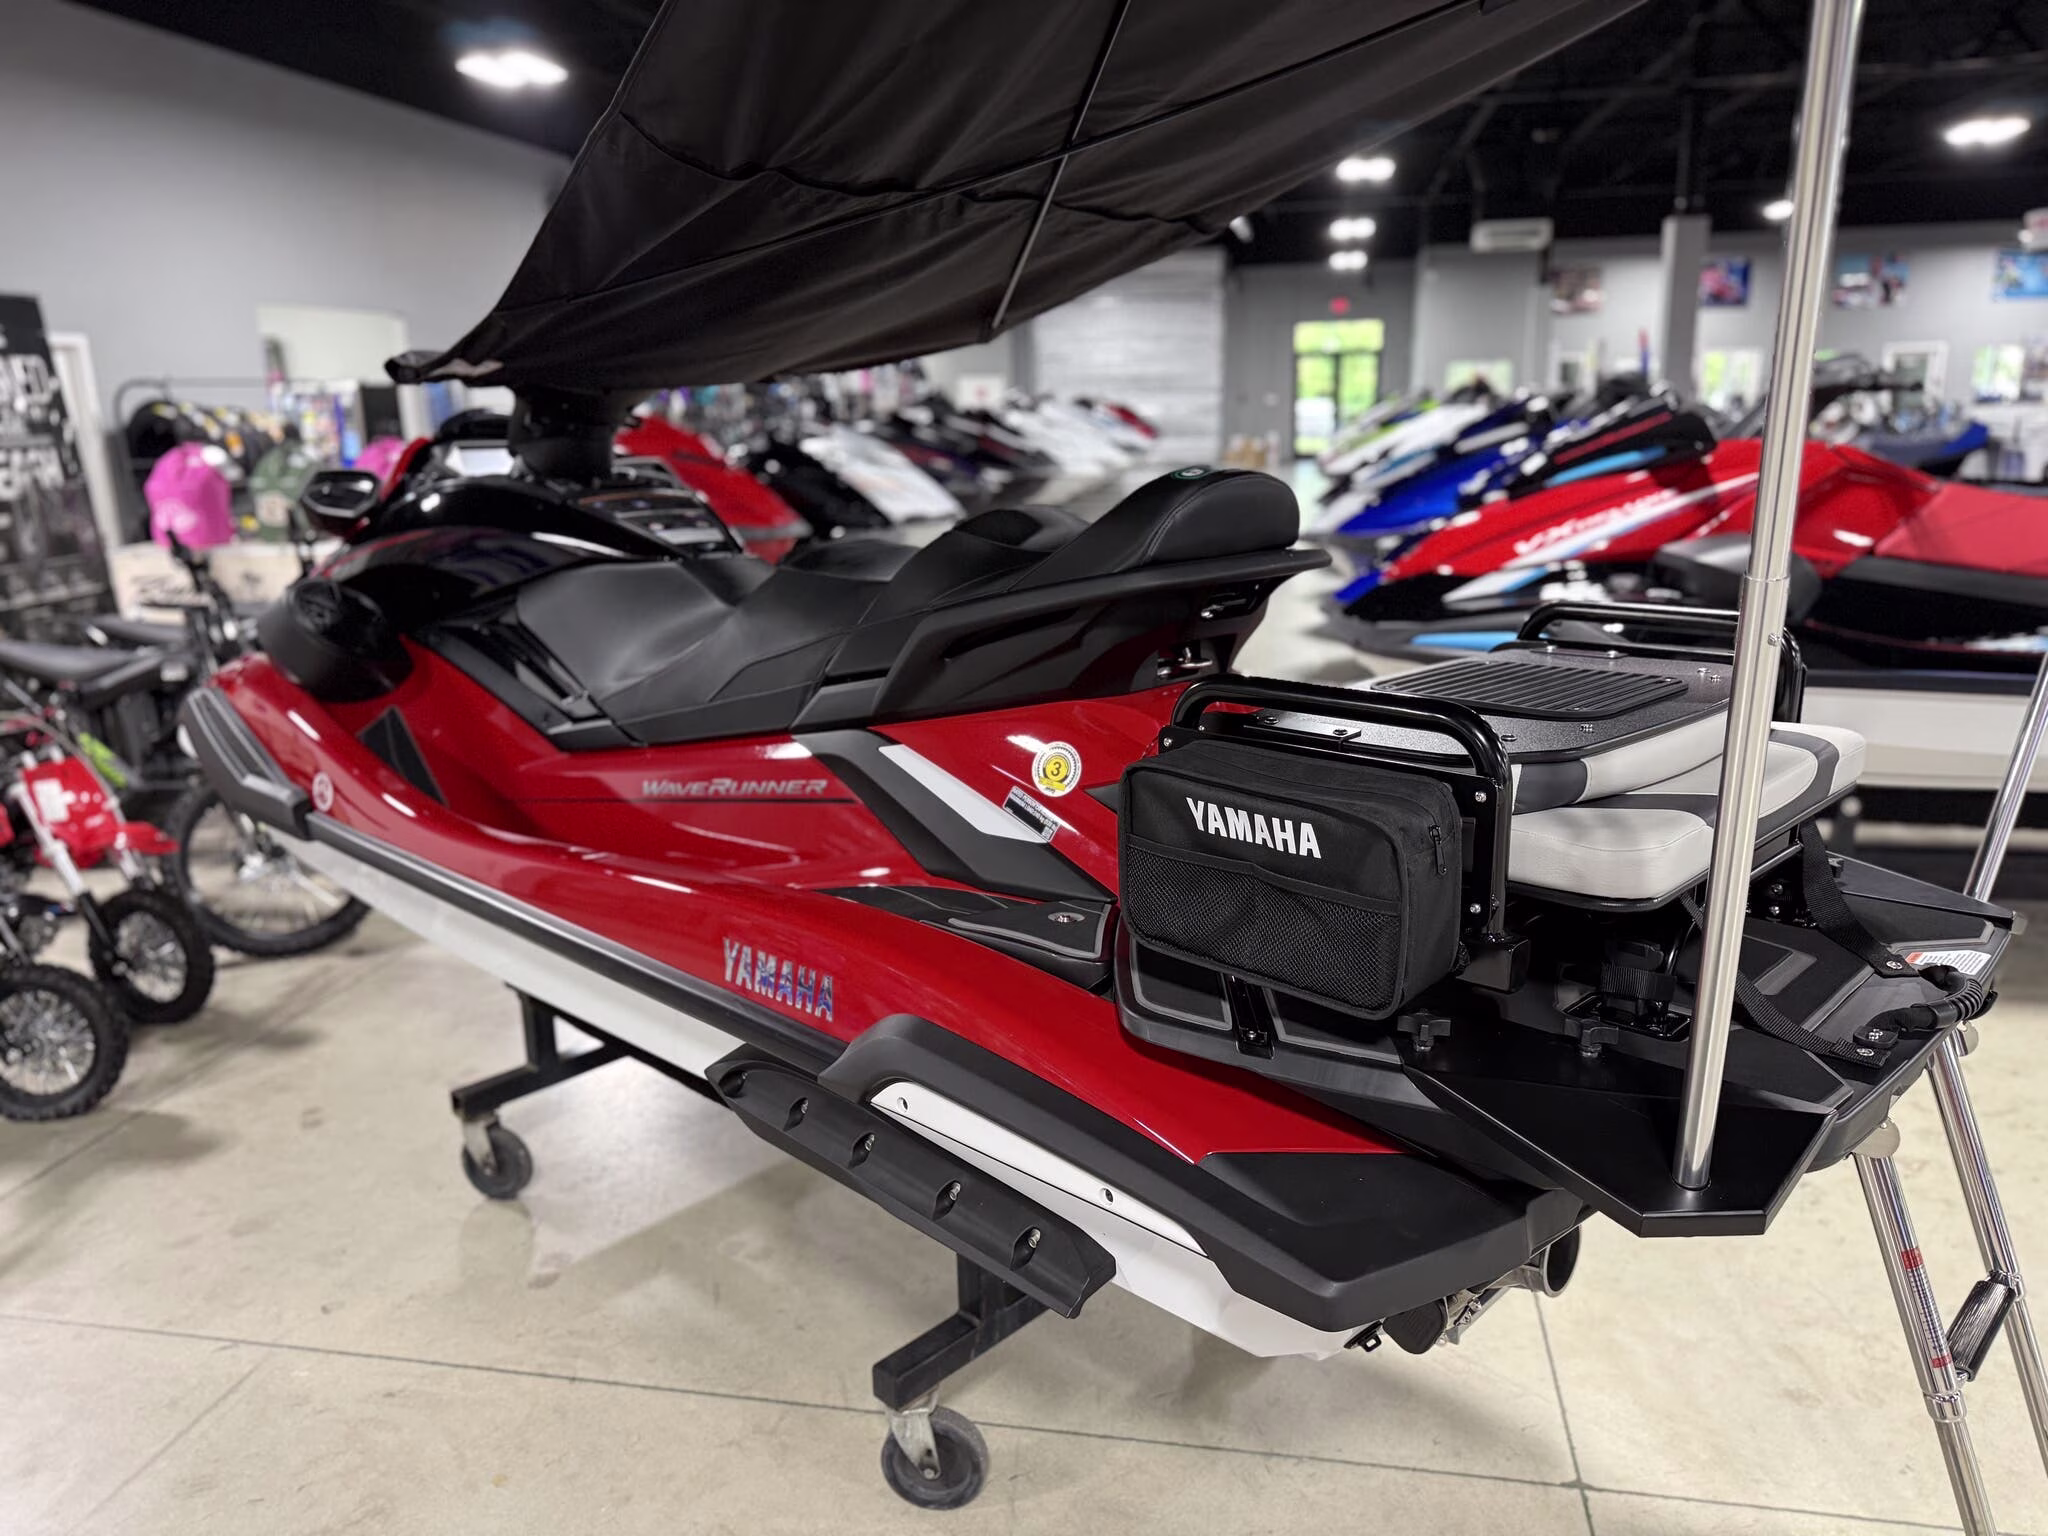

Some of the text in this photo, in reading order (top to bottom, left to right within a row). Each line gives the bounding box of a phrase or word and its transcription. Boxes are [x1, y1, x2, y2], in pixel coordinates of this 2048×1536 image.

[1050, 761, 1062, 777] 3
[1186, 797, 1322, 859] YAMAHA
[722, 936, 834, 1022] YAMAHA
